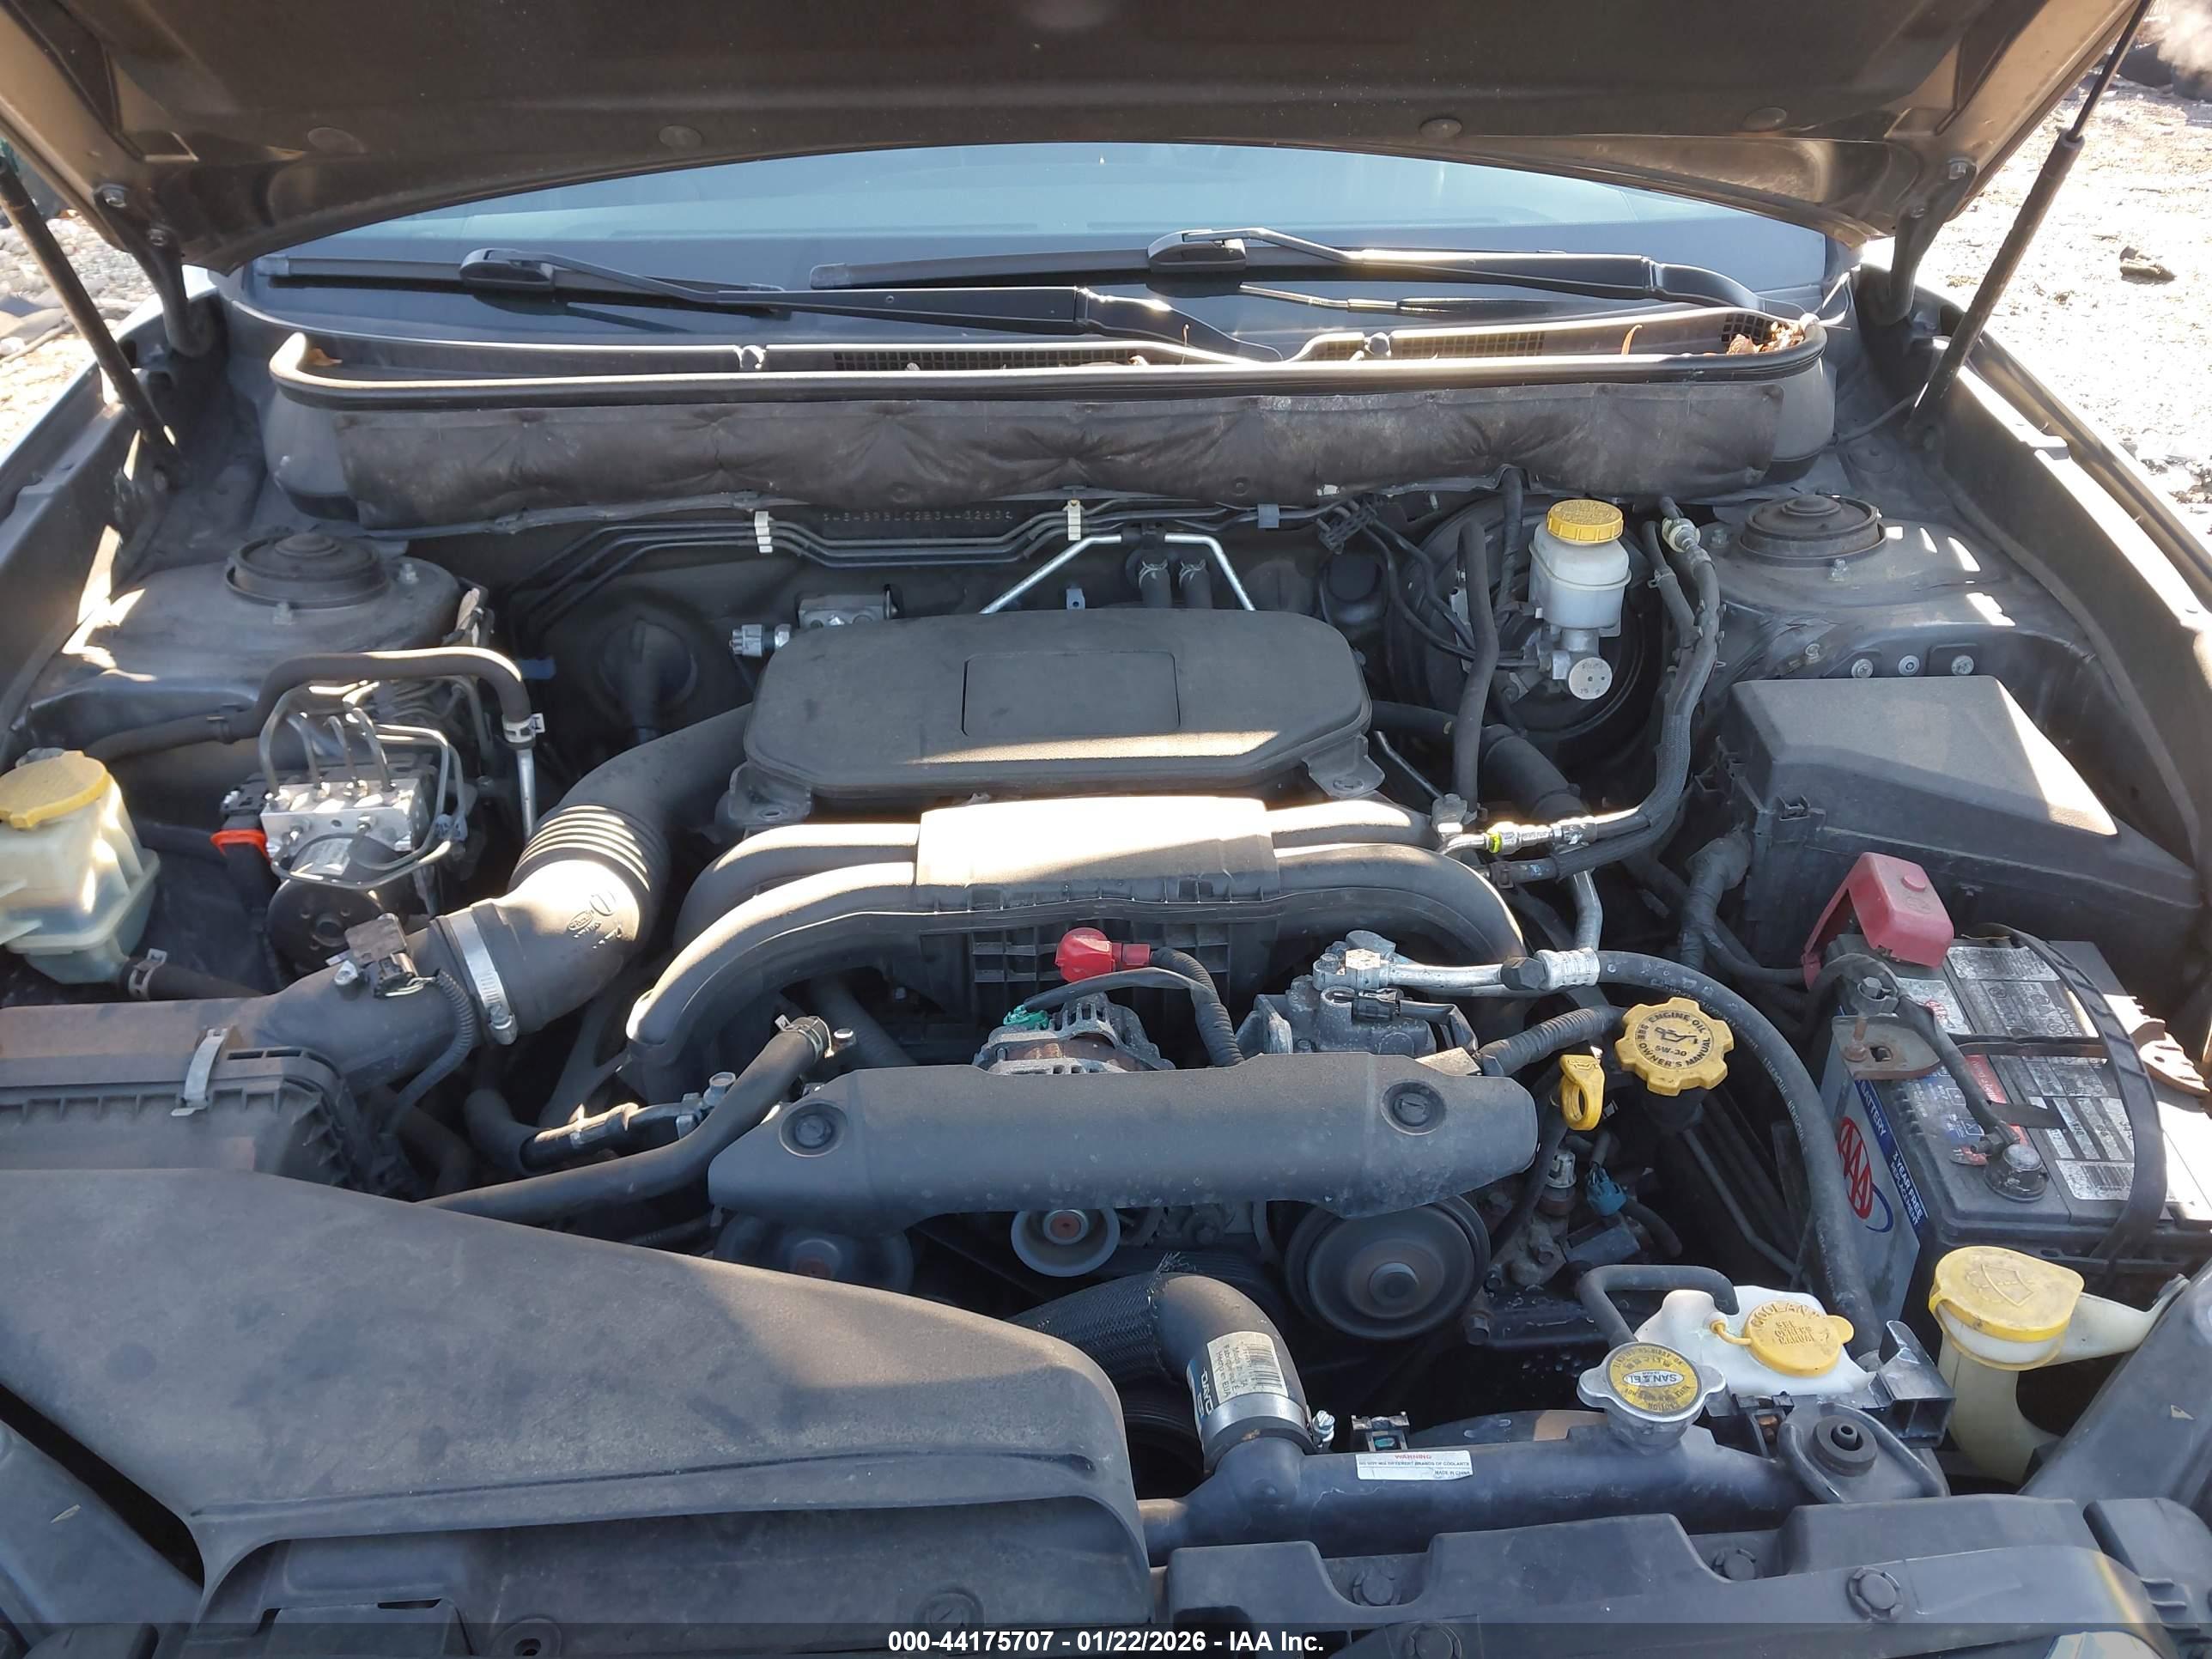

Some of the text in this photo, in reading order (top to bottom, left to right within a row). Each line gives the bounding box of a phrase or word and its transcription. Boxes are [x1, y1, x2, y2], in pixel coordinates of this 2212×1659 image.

[1637, 1024, 1711, 1067] SEE OWNER'S MANUAL
[1648, 1012, 1706, 1034] ENGINE OIL
[1655, 1045, 1687, 1057] 5W-30
[1860, 1084, 1887, 1136] BATTERY
[1837, 1117, 1874, 1219] AAA
[1889, 1161, 1919, 1227] REPLACEMENT
[1892, 1152, 1923, 1221] 3 YEAR FREE
